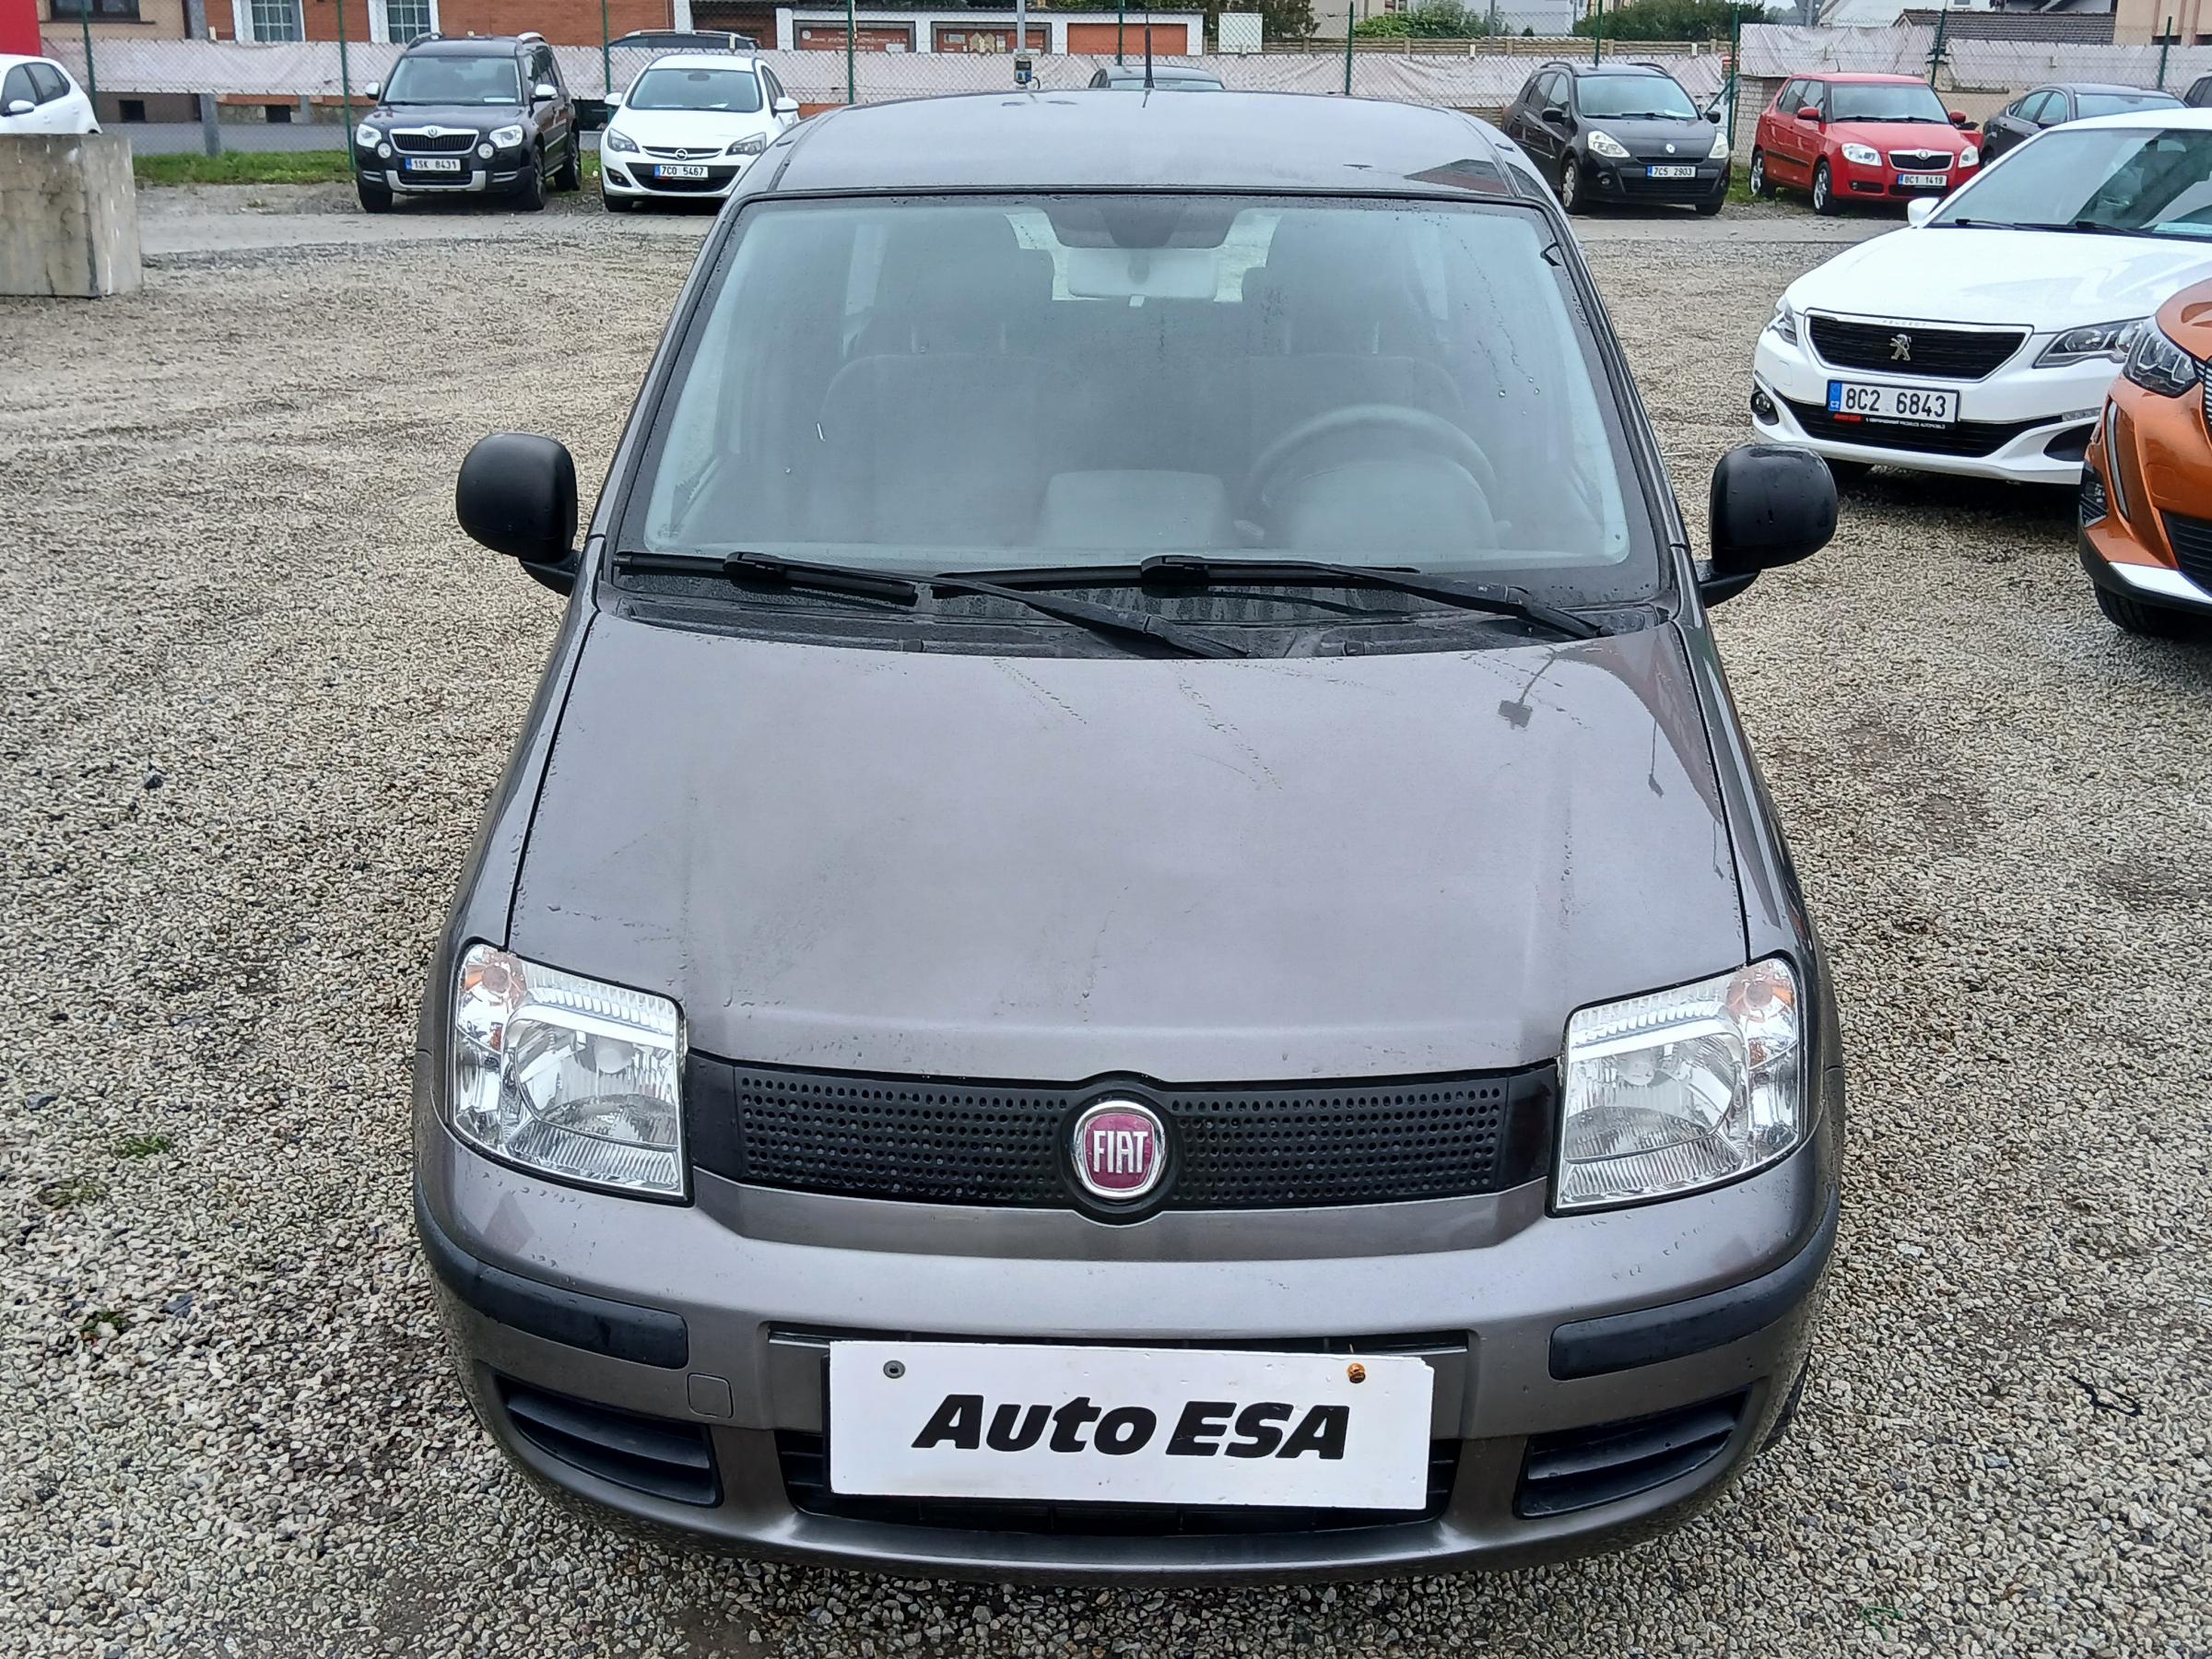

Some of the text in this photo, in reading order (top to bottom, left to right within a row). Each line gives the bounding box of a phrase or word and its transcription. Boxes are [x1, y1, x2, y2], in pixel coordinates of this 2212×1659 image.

[683, 166, 704, 176] 5467
[1845, 387, 1947, 418] 8C2 6843
[1093, 1130, 1148, 1173] FIAT
[912, 1394, 1350, 1460] Auto ESA
